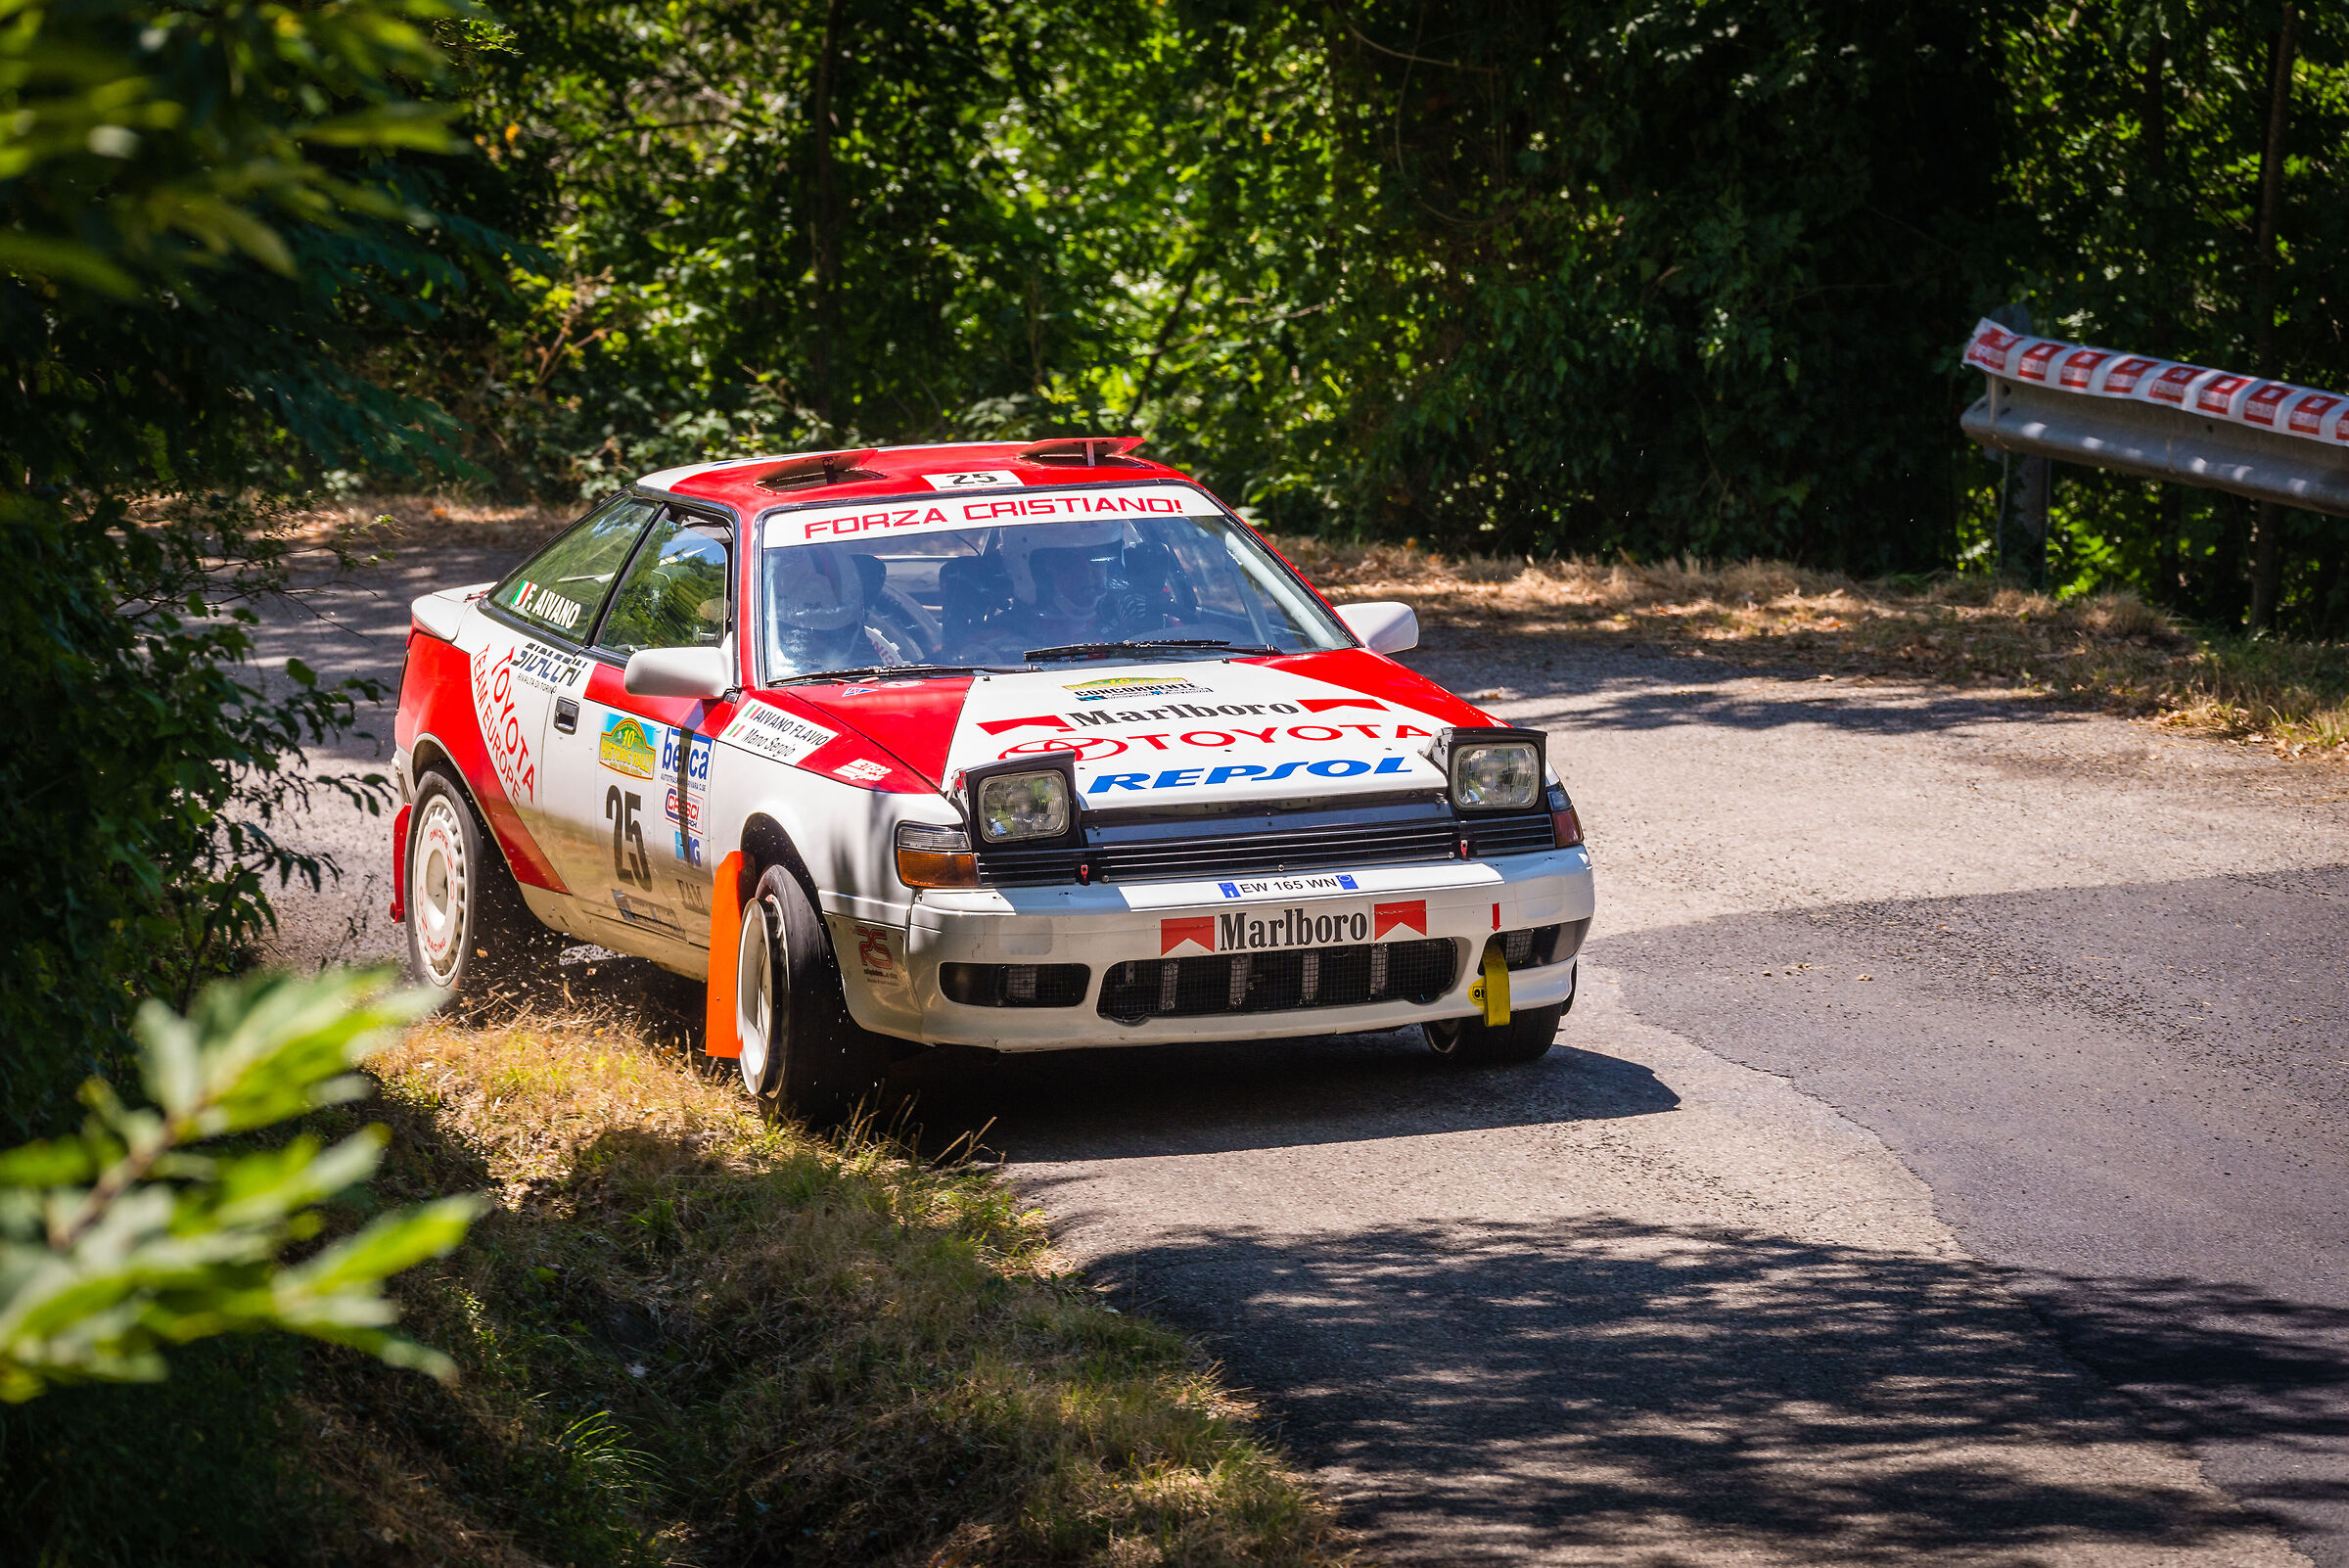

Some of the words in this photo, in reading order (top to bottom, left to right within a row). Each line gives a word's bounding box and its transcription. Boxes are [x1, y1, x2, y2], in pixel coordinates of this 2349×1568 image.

[947, 472, 997, 485] 25
[805, 508, 948, 539] FORZA
[963, 497, 1183, 521] CRISTIANO!
[531, 589, 580, 629] AIVANO
[1075, 682, 1196, 697] CONCORRENTE
[474, 643, 490, 709] TEAM
[483, 702, 521, 806] EUROPE
[491, 646, 534, 804] TOYOTA
[753, 709, 794, 732] AIVANO
[789, 720, 830, 746] FLAVIO
[1066, 699, 1299, 726] Marlboro
[601, 738, 632, 764] HISTORIC
[632, 752, 654, 774] RALLY
[764, 737, 796, 758] Sergio
[1128, 724, 1432, 751] TOYOTA
[1086, 757, 1414, 794] REPSOL
[606, 785, 653, 893] 25
[1239, 883, 1267, 895] EW
[1273, 880, 1303, 891] 165
[1306, 877, 1338, 890] WN
[1220, 908, 1367, 951] Marlboro
